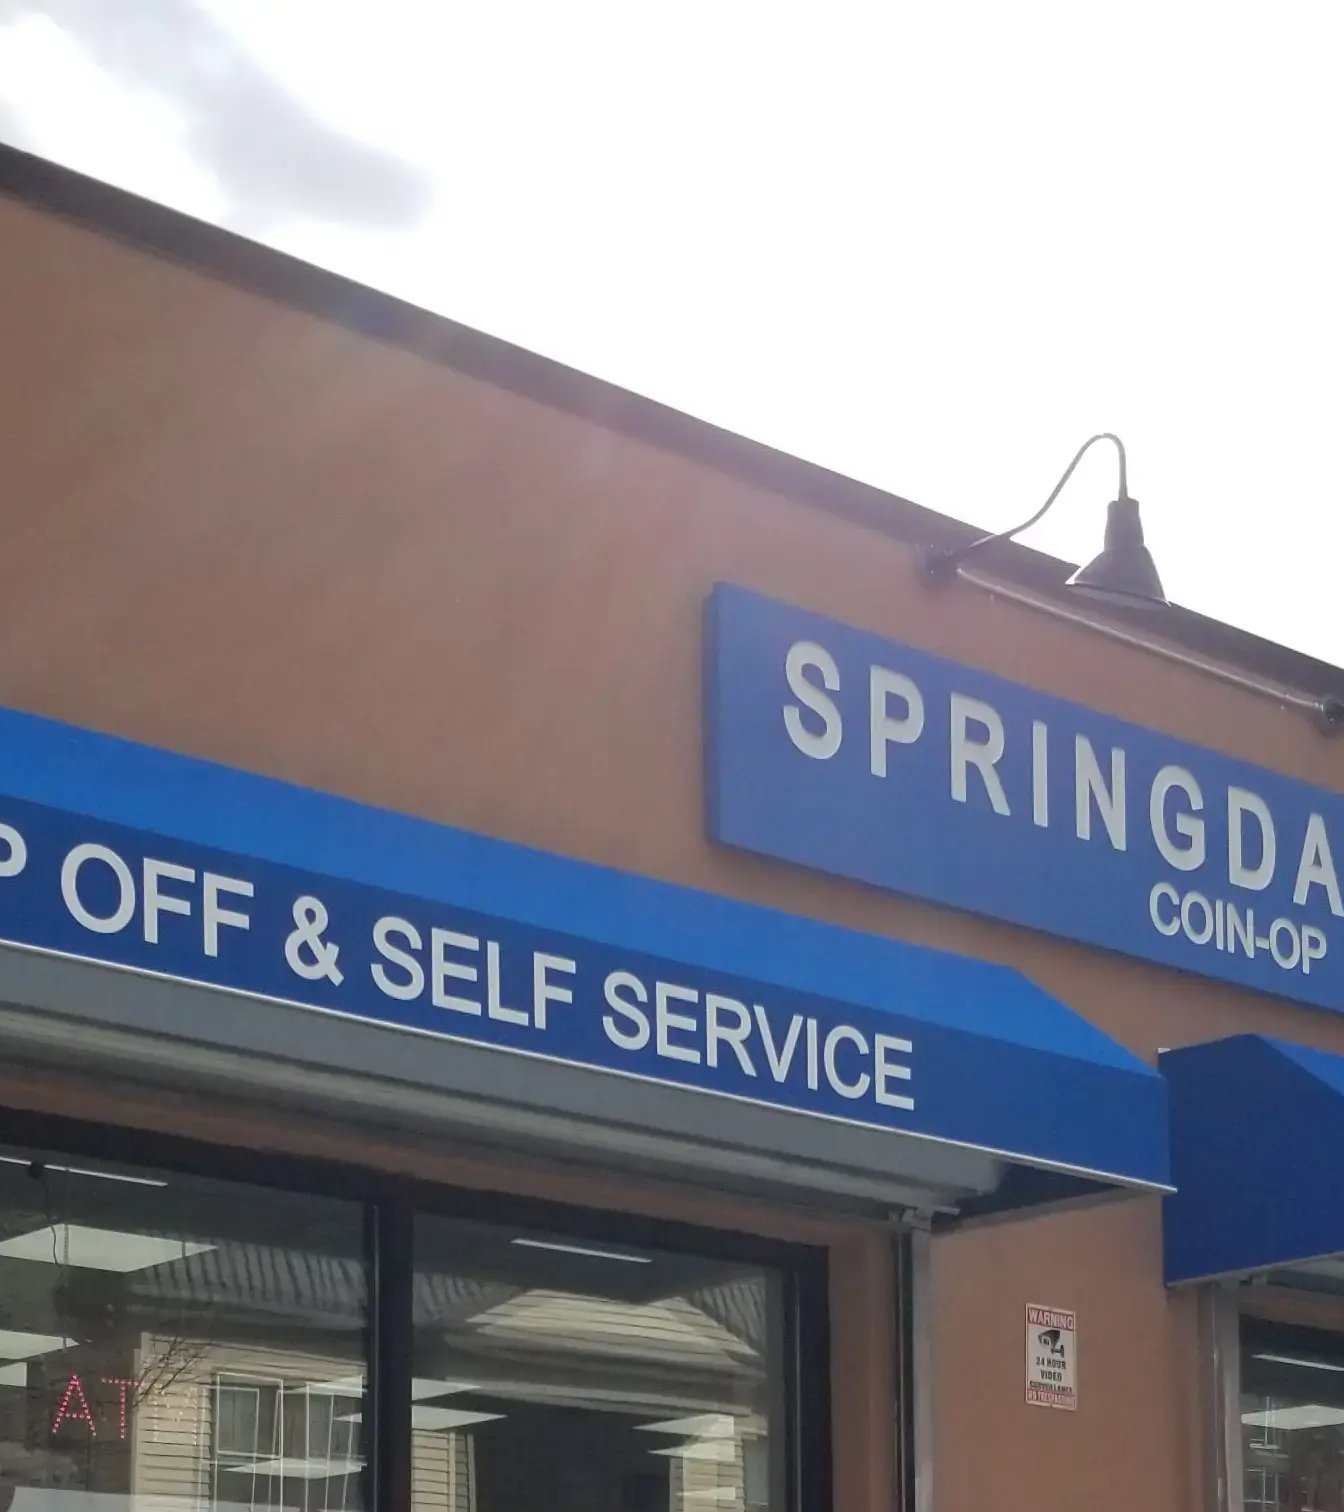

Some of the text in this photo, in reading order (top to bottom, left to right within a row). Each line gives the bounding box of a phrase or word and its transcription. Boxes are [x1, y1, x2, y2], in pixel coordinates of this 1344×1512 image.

[1149, 881, 1328, 975] COIN-OP
[60, 843, 254, 957] OFF
[284, 896, 344, 986] &
[371, 916, 576, 1030] SELF
[603, 971, 914, 1110] SERVICE
[1027, 1308, 1074, 1330] WARNING
[1046, 1358, 1066, 1370] HOUR
[1040, 1370, 1062, 1382] VIDEO
